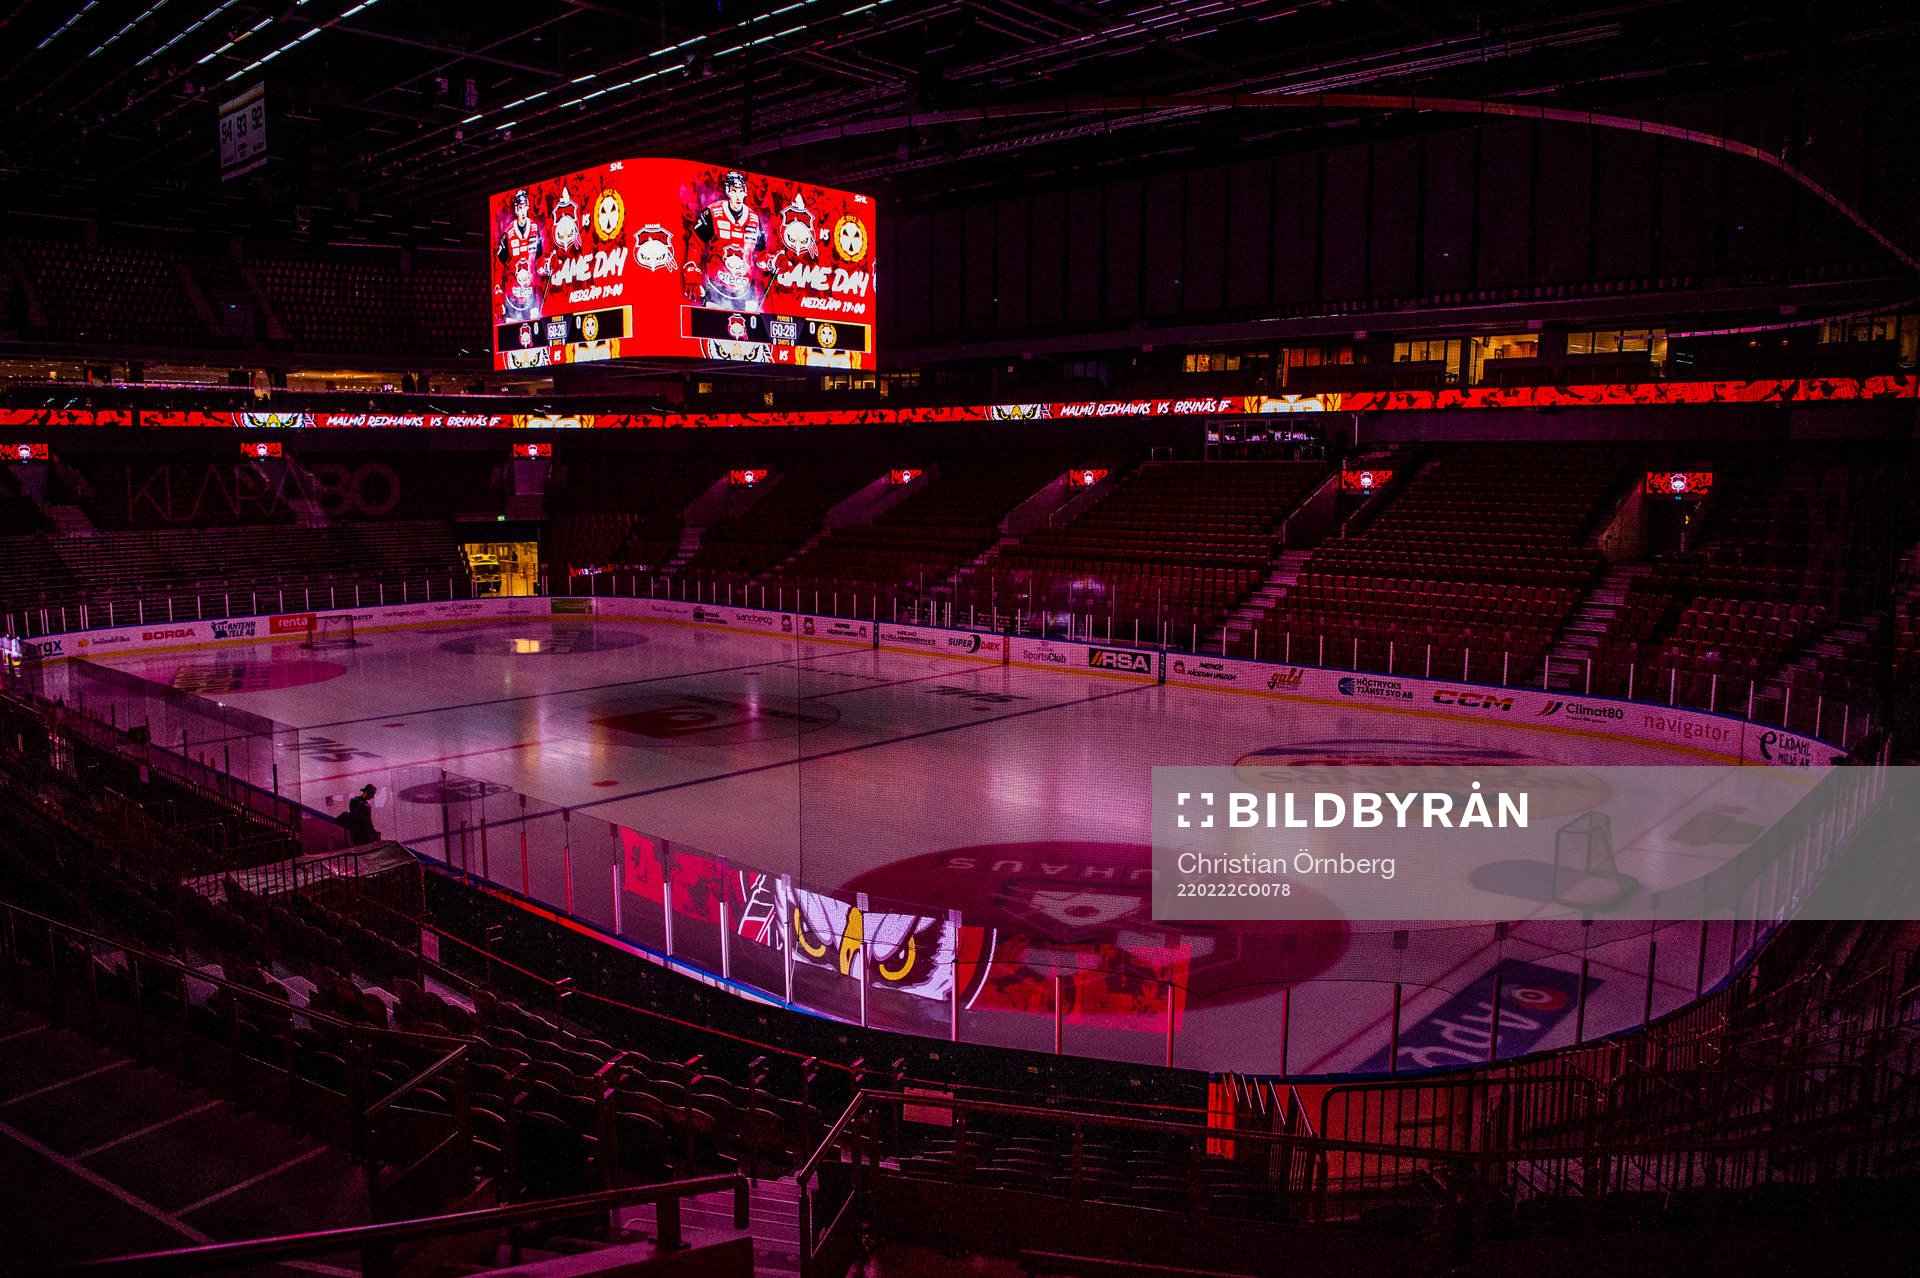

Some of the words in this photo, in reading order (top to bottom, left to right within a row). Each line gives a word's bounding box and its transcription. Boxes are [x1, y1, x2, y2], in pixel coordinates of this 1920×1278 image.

[593, 247, 628, 279] DAY
[832, 268, 869, 297] DAY
[801, 297, 842, 312] NEDSLÄPP
[842, 302, 866, 315] 19:00
[533, 322, 539, 336] 0
[576, 315, 581, 330] 0
[750, 316, 757, 330] 0
[809, 321, 816, 335] 0
[771, 323, 796, 338] 60:28
[1060, 402, 1096, 417] MALMÖ
[1096, 402, 1152, 416] REDHAWKS
[1157, 402, 1170, 414] VS
[1174, 398, 1216, 414] BRYNÄS
[1218, 400, 1231, 412] IF
[326, 414, 366, 427] MALMÖ
[367, 416, 424, 427] REDHAWKS
[430, 416, 442, 426] VS
[447, 414, 487, 427] BRYNÄS
[488, 416, 501, 427] IF
[278, 616, 309, 628] renta
[143, 629, 196, 641] BORGA
[948, 637, 972, 648] SUPER
[1023, 649, 1067, 664] SportsClub
[1103, 652, 1150, 672] RSA
[1356, 677, 1402, 690] HÖGTRYCKS
[1385, 689, 1401, 698] SYD
[1402, 691, 1414, 699] AB
[1433, 690, 1514, 711] CCM
[1566, 703, 1624, 719] Climat80
[1643, 715, 1730, 742] navigator
[1778, 733, 1811, 757] EKDAHL
